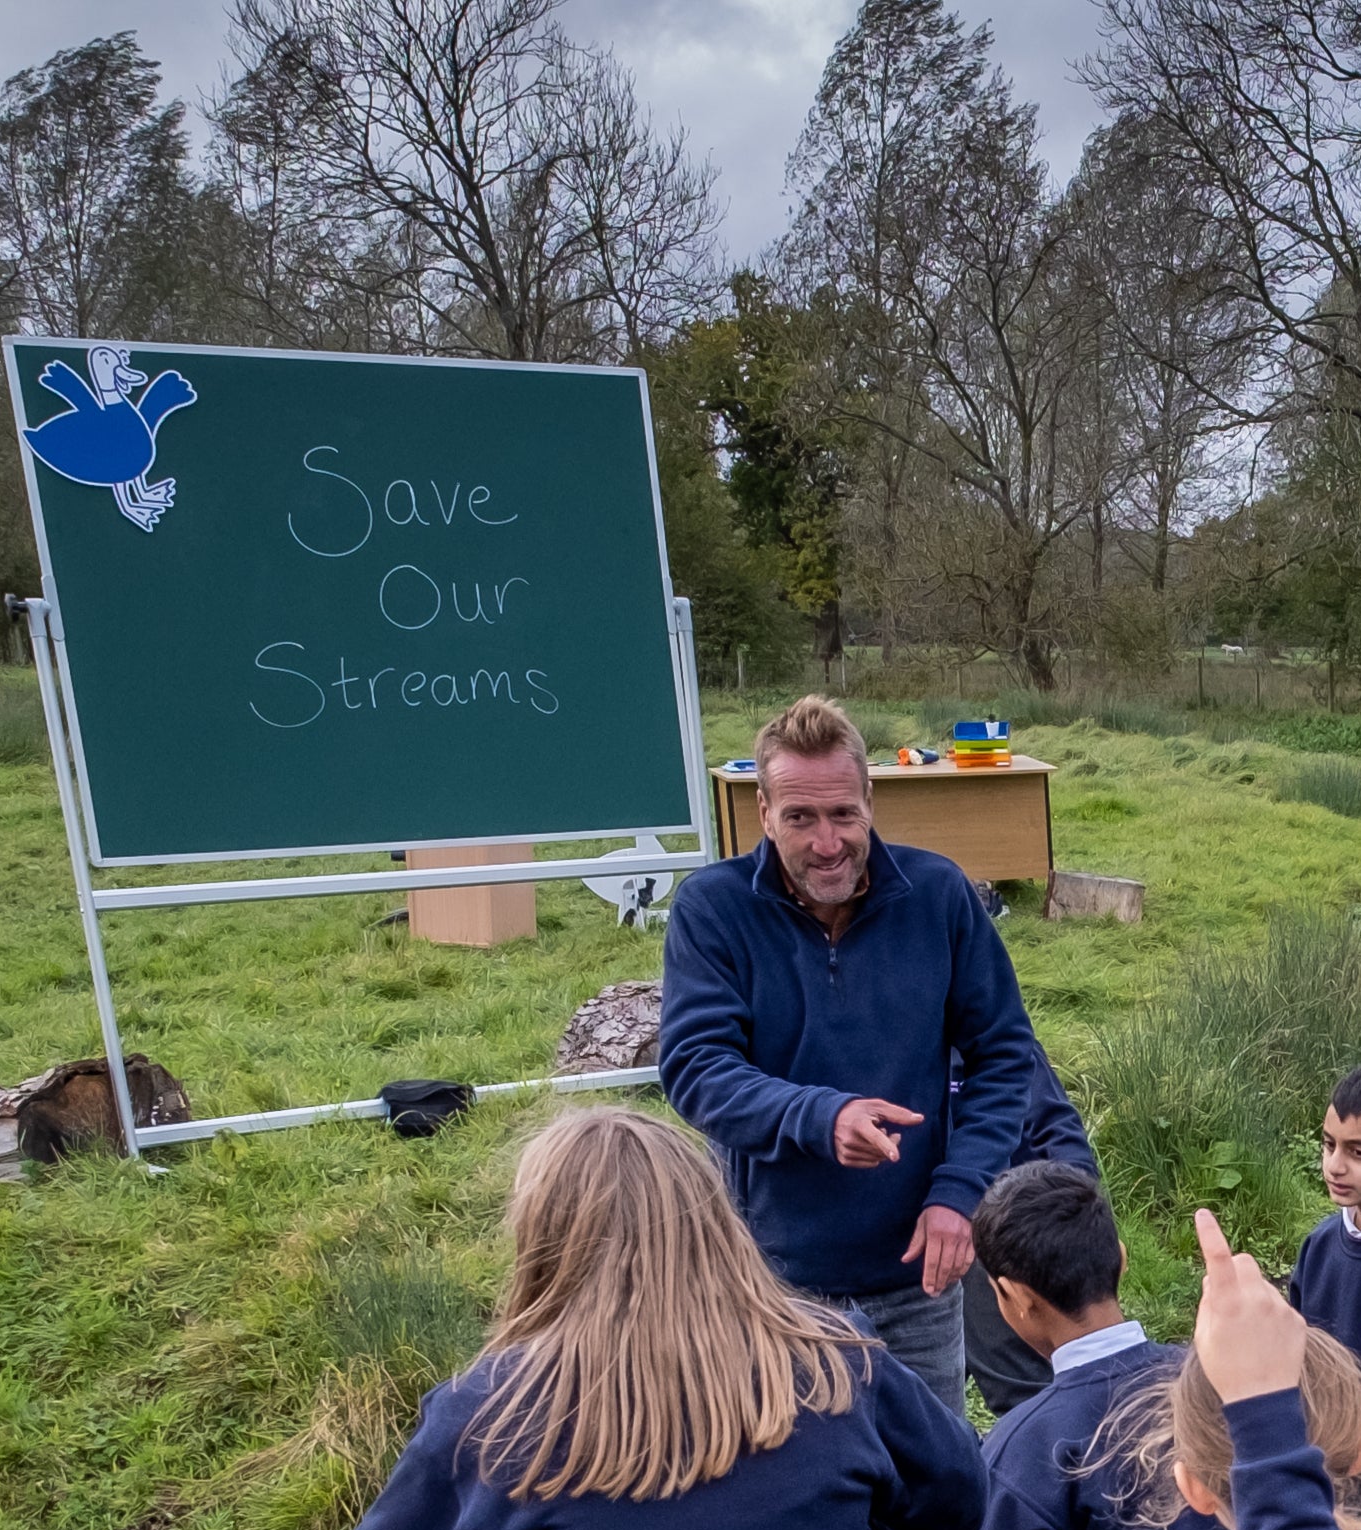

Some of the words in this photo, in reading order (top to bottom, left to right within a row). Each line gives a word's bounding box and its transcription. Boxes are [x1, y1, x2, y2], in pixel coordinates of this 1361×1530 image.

[288, 445, 518, 557] Save
[379, 564, 530, 630] Our
[249, 641, 559, 728] Streams
